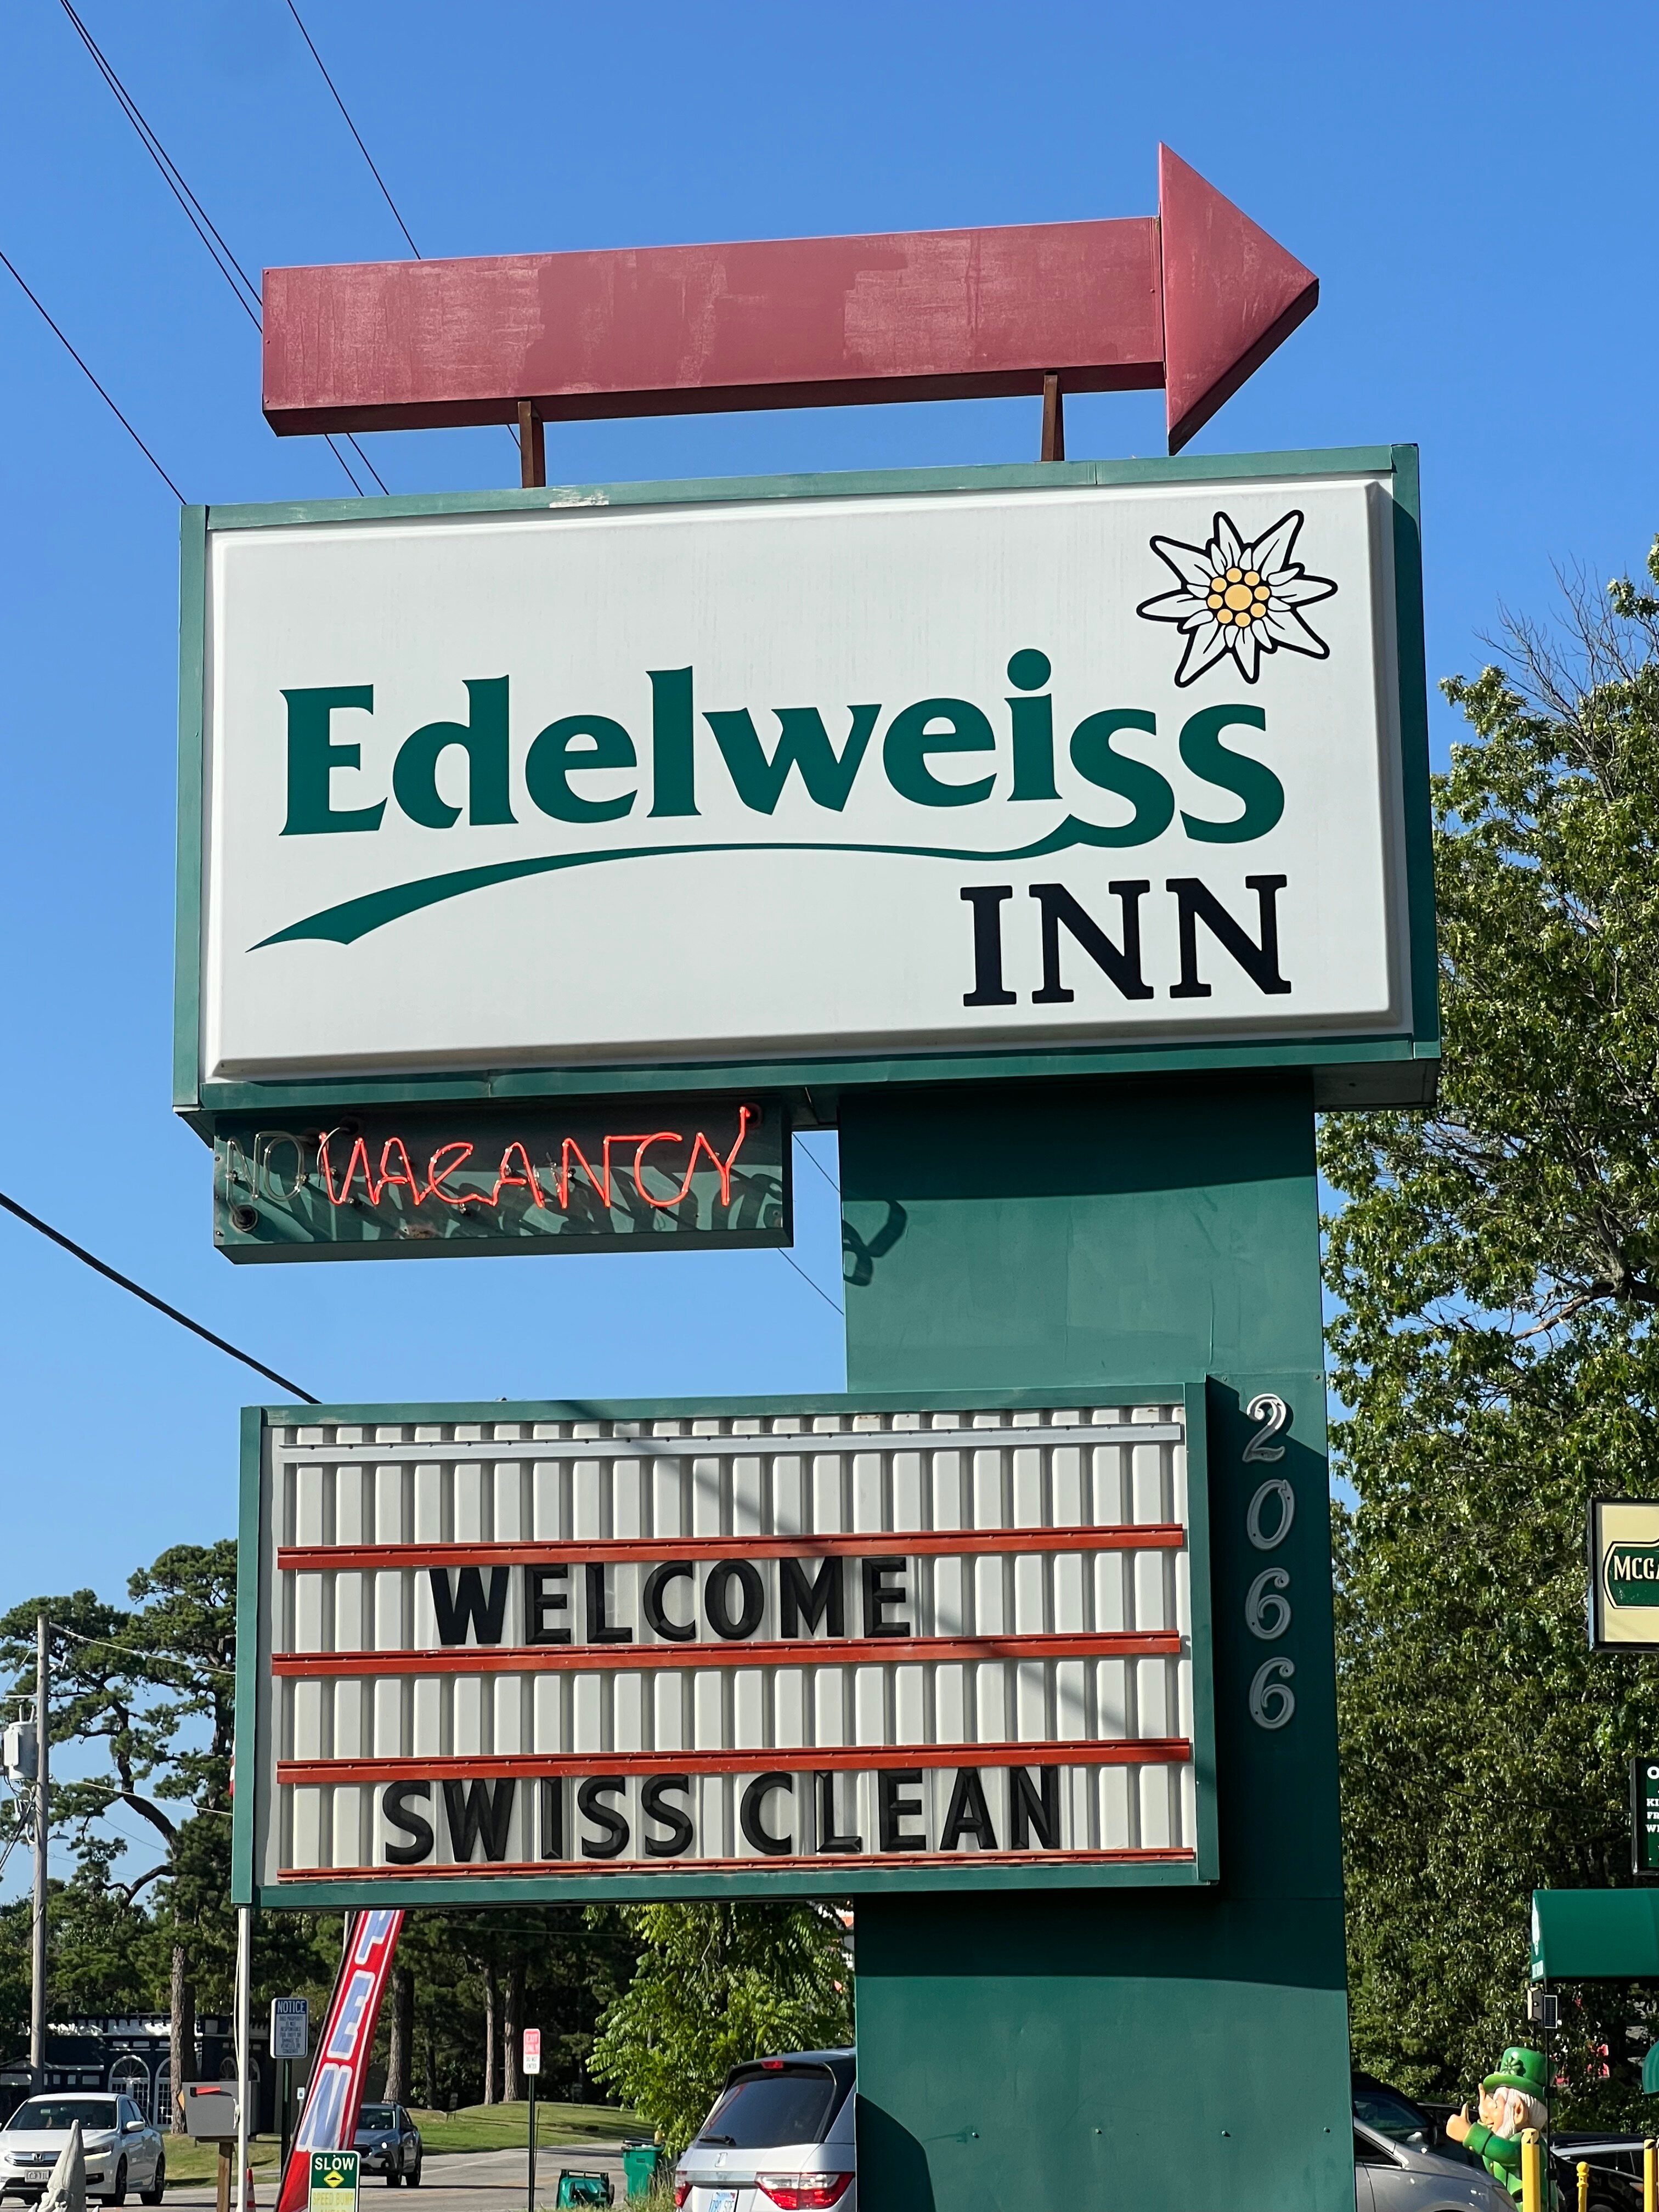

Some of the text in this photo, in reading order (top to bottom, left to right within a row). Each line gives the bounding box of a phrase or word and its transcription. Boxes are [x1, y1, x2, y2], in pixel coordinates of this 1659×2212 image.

[278, 648, 1285, 848] Edelweiss
[960, 874, 1291, 1007] INN
[320, 1107, 753, 1208] VACANCY
[430, 1556, 911, 1645] WELCOME
[1242, 1393, 1296, 1730] 2066
[1613, 1555, 1659, 1581] MCG
[383, 1765, 1059, 1865] SWISS CLEAN
[277, 2000, 306, 2013] NOTICE
[313, 2192, 354, 2205] SPEED BUMP
[314, 2157, 354, 2170] SLOW
